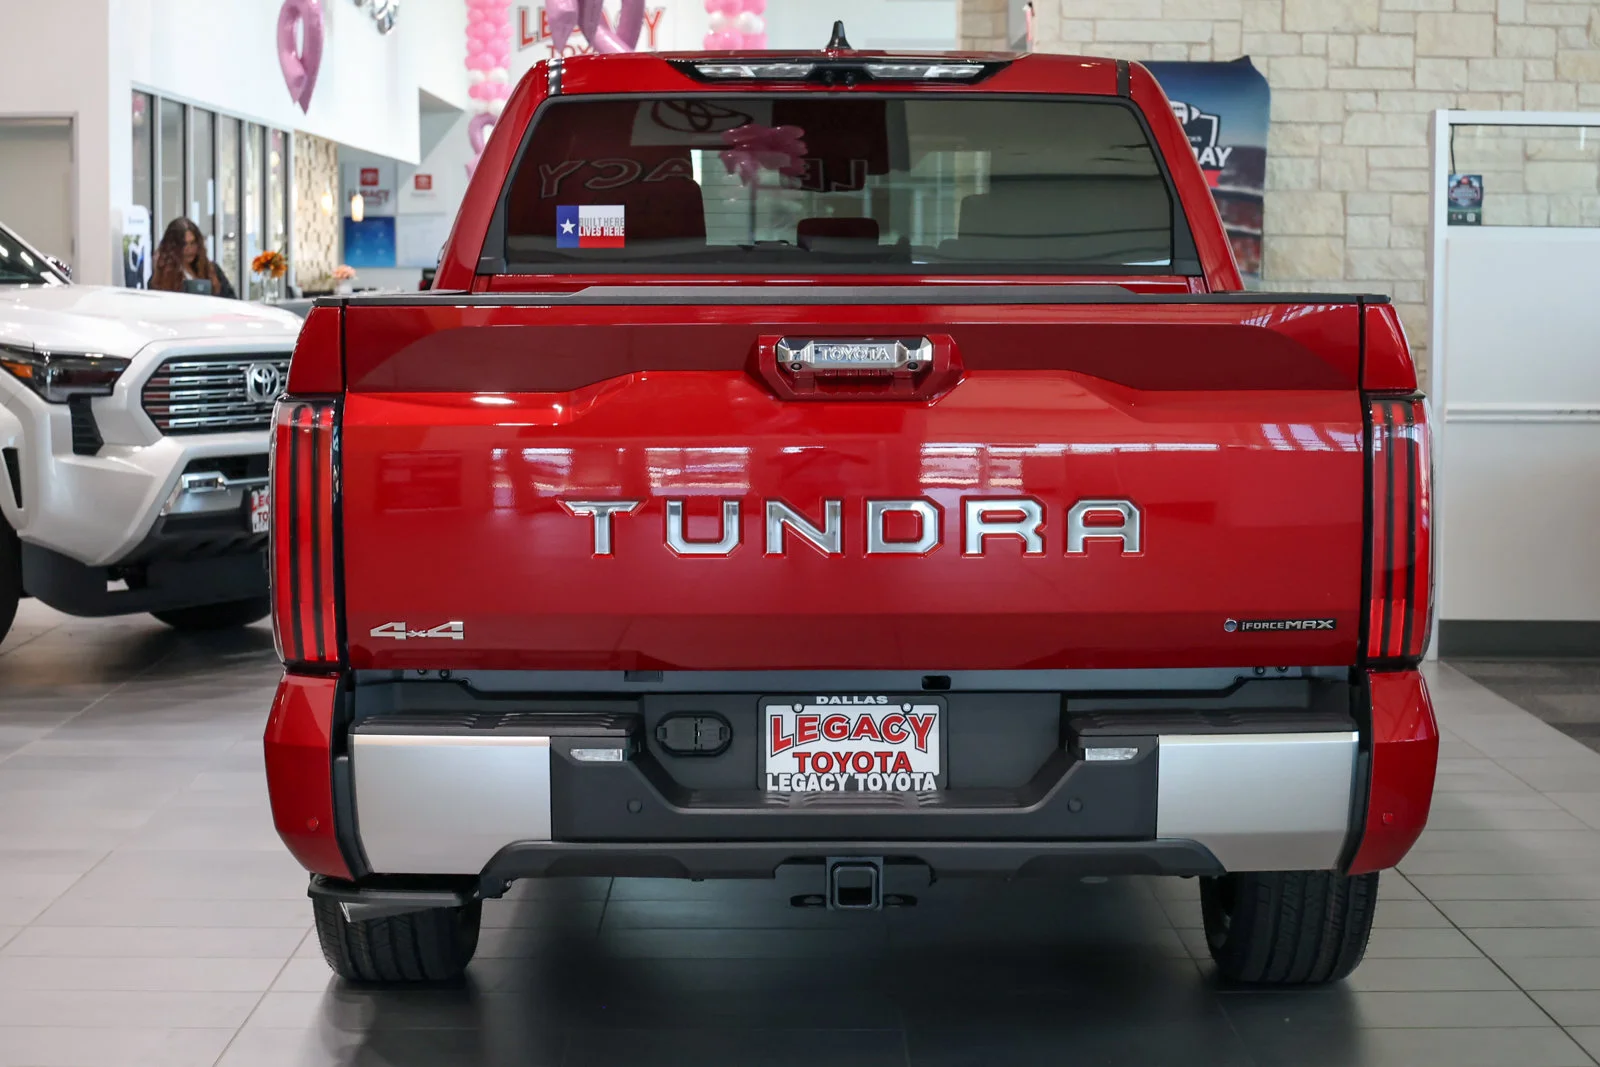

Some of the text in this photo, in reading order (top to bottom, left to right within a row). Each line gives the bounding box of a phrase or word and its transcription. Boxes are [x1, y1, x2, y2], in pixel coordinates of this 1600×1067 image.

[579, 217, 624, 227] BUILT HERE
[579, 226, 624, 236] LIVES HERE
[819, 346, 890, 361] TOYOTA
[563, 499, 1144, 556] TUNDRA
[370, 621, 464, 640] 4x4
[816, 695, 889, 705] DALLAS
[770, 713, 937, 757] LEGACY
[792, 751, 914, 774] TOYOTA
[766, 772, 938, 793] LEGACY TOYOTA
